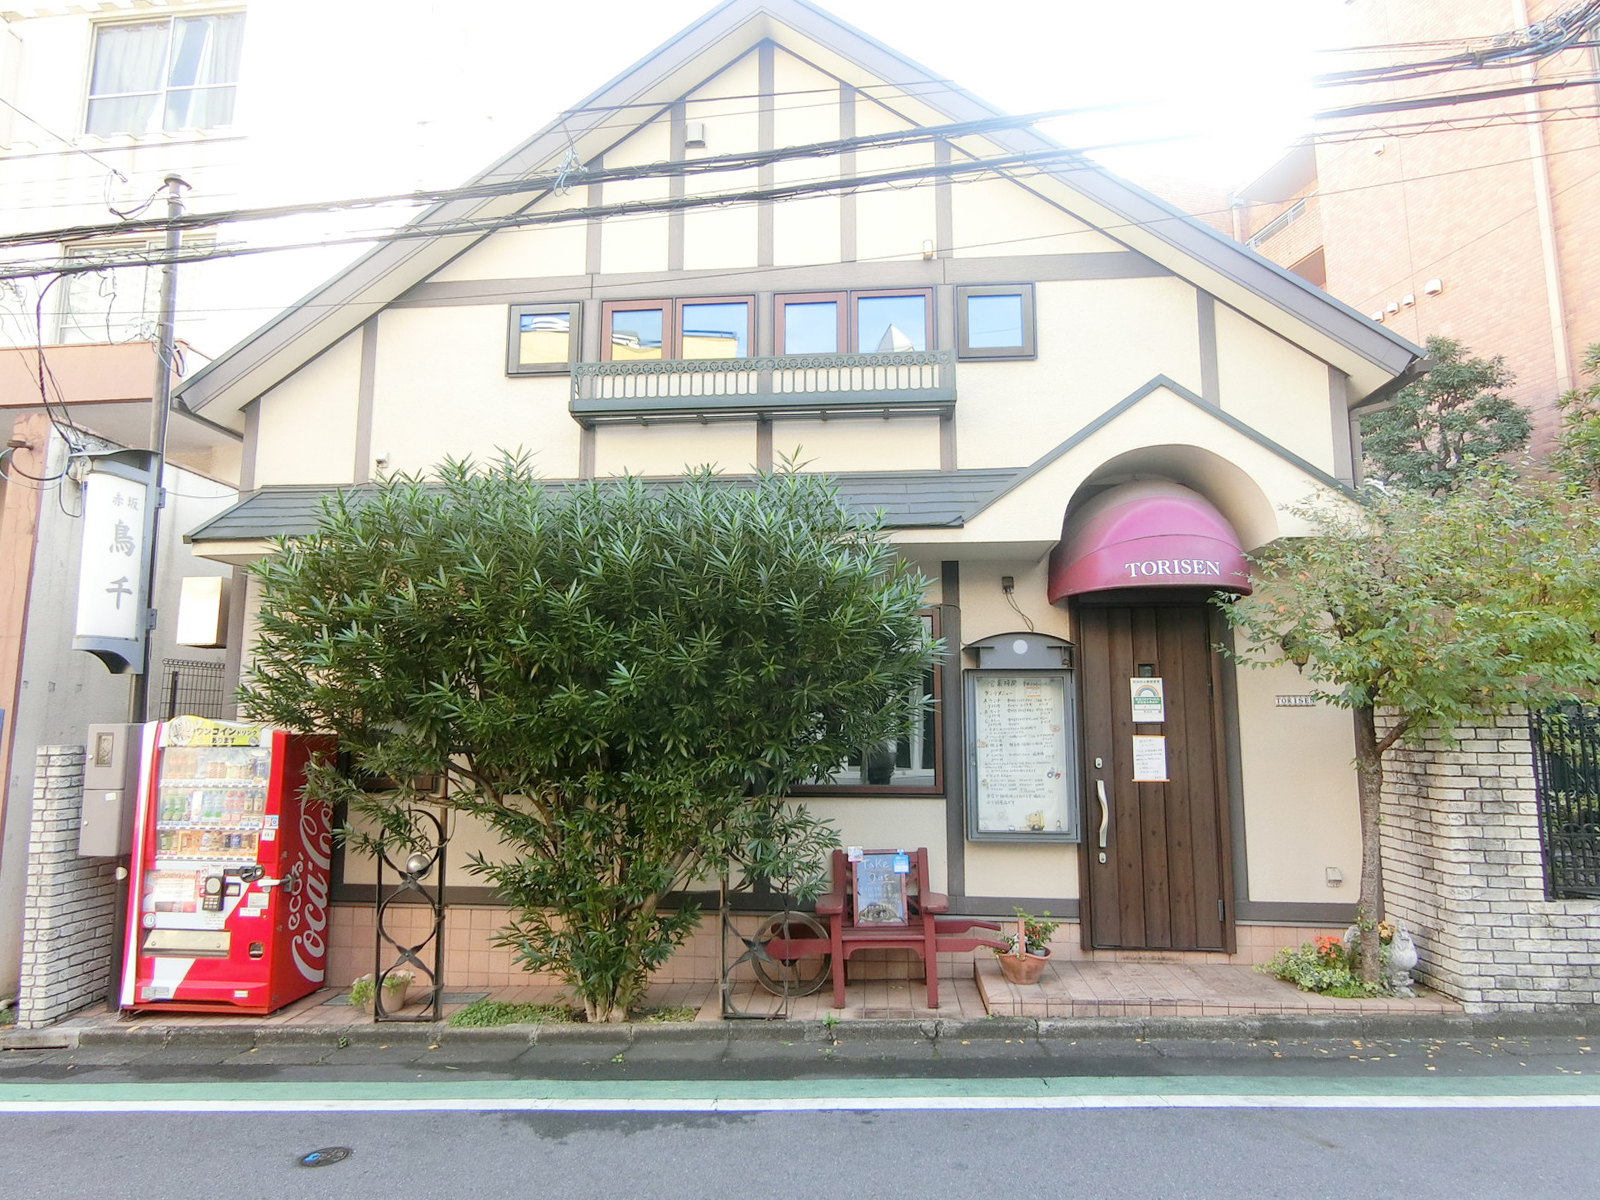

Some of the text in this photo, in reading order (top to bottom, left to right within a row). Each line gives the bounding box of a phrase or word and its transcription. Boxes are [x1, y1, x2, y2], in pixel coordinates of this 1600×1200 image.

[112, 492, 139, 511] 赤坂
[105, 518, 136, 610] 鳥千
[1124, 559, 1220, 578] TORISEN
[860, 859, 890, 870] Take
